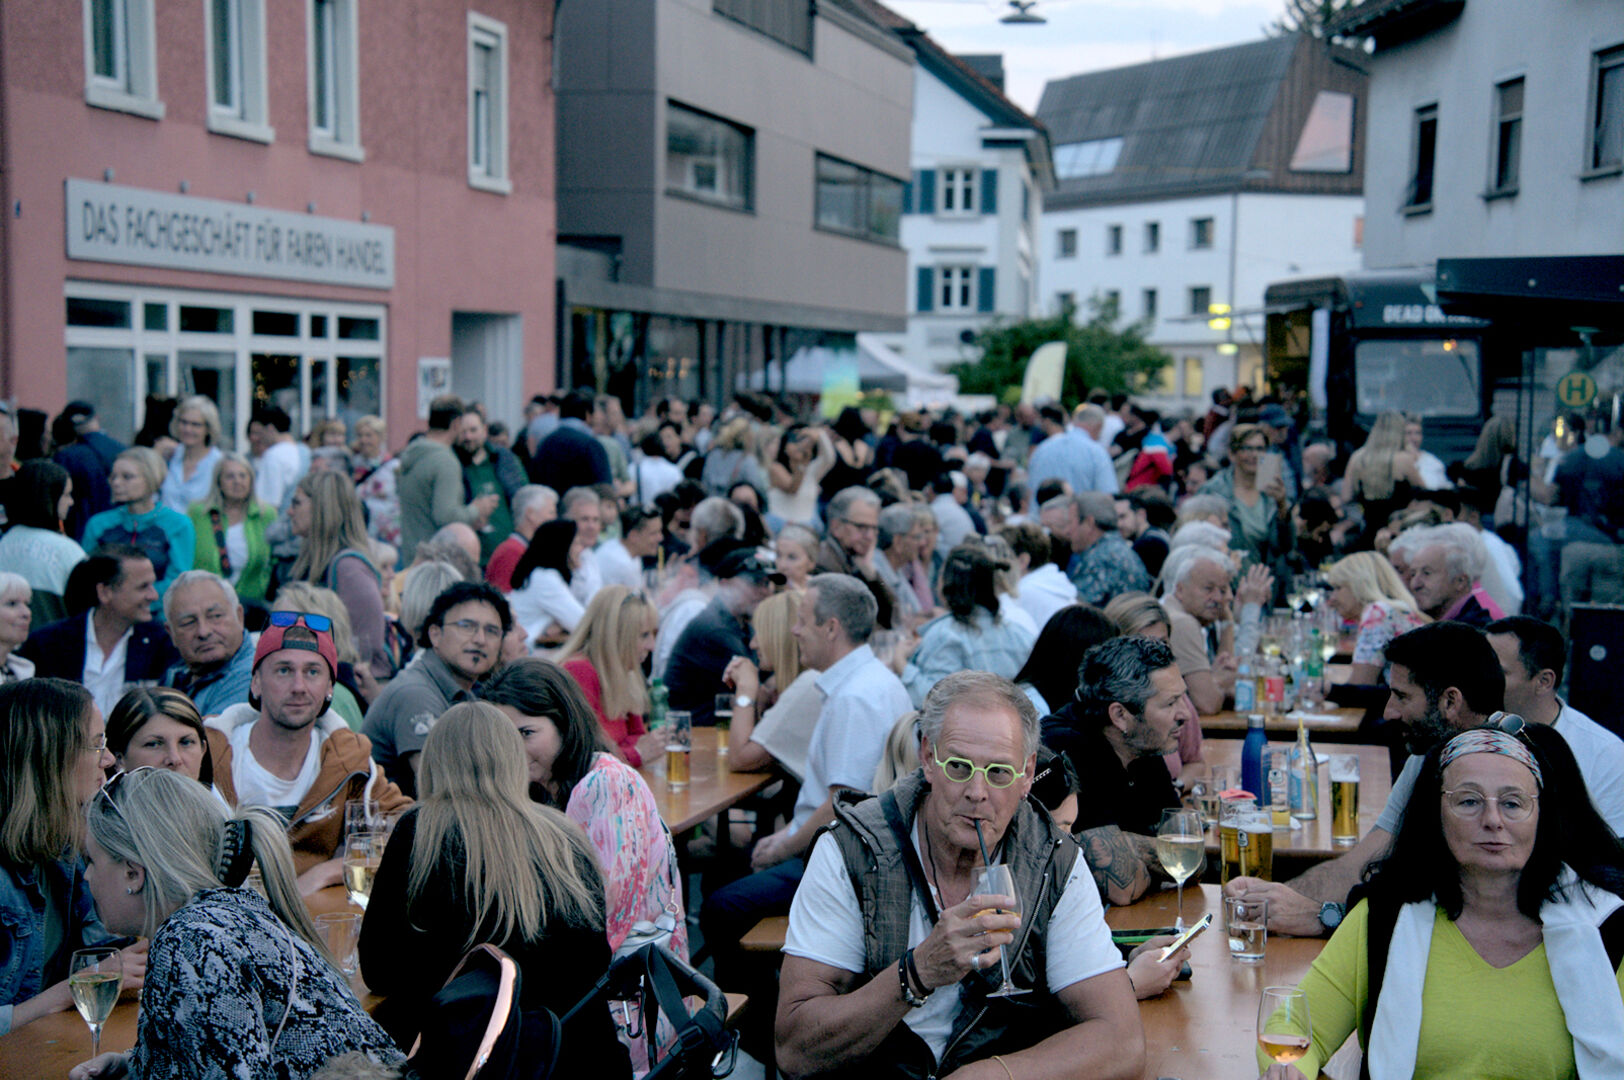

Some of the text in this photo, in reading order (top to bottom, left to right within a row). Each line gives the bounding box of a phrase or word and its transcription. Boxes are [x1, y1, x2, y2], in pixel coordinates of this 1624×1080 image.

[82, 199, 387, 275] DAS FACHGESCHÄFT FÜR FAIREN HANDEL
[1567, 378, 1586, 400] H
